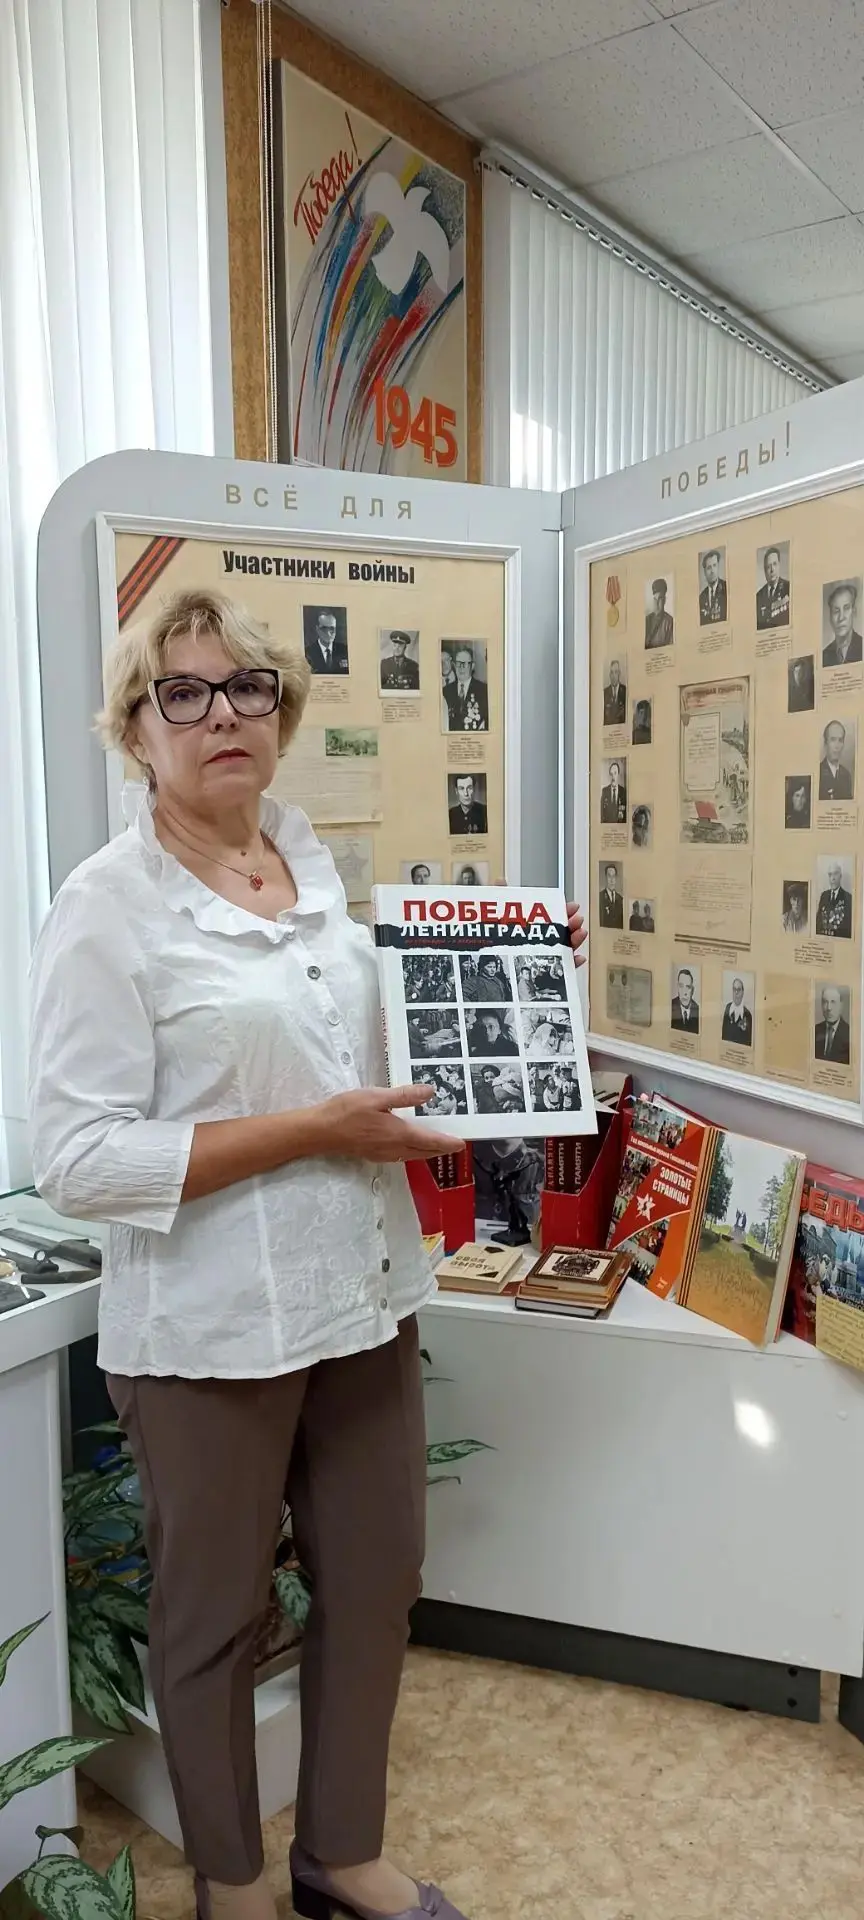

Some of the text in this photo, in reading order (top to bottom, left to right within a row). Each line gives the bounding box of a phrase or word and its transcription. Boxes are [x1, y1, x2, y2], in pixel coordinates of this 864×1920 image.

[294, 111, 362, 245] Победа!
[373, 378, 459, 468] 1945
[661, 421, 790, 499] ПОБЕДЫ!
[225, 484, 412, 520] ВСЁ ДЛЯ
[222, 550, 415, 584] Участники войны
[403, 900, 553, 928] ПОБЕДА
[400, 923, 560, 941] ЛЕНИНГРАДА
[574, 1142, 582, 1185] ПАМЯТИ
[660, 1166, 692, 1191] ЗОЛОТЫЕ
[652, 1179, 690, 1206] СТРАНИЦЫ
